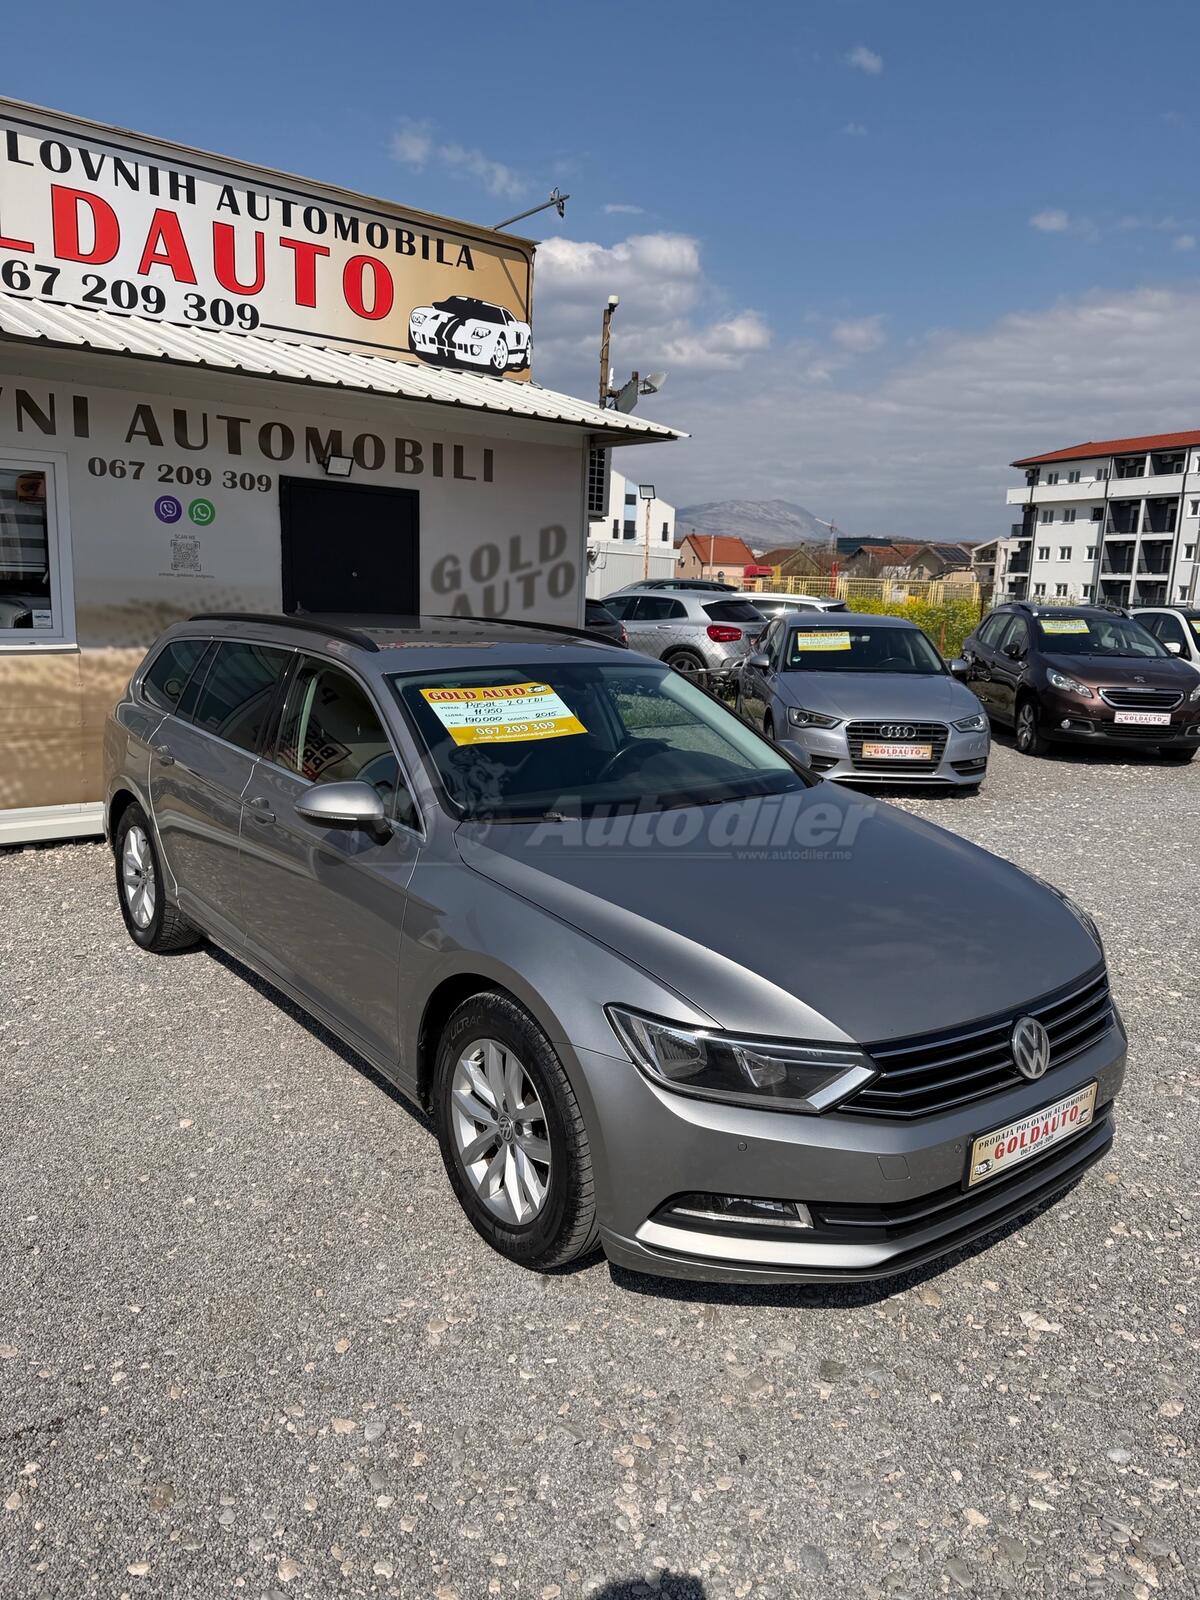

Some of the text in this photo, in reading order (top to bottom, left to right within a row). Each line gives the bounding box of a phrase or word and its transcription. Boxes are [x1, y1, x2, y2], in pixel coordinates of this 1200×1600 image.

[6, 129, 475, 271] LOVNIH AUTOMOBILA
[1, 259, 260, 330] 67 209 309
[0, 386, 494, 482] NI AUTOMOBILI
[88, 456, 272, 493] 067 209 309
[430, 524, 567, 594] GOLD
[451, 560, 575, 617] AUTO
[428, 687, 526, 701] GOLD AUTO
[476, 727, 500, 735] 067
[503, 724, 528, 733] 209
[531, 721, 555, 730] 309
[995, 1105, 1078, 1160] GOLDAUTO
